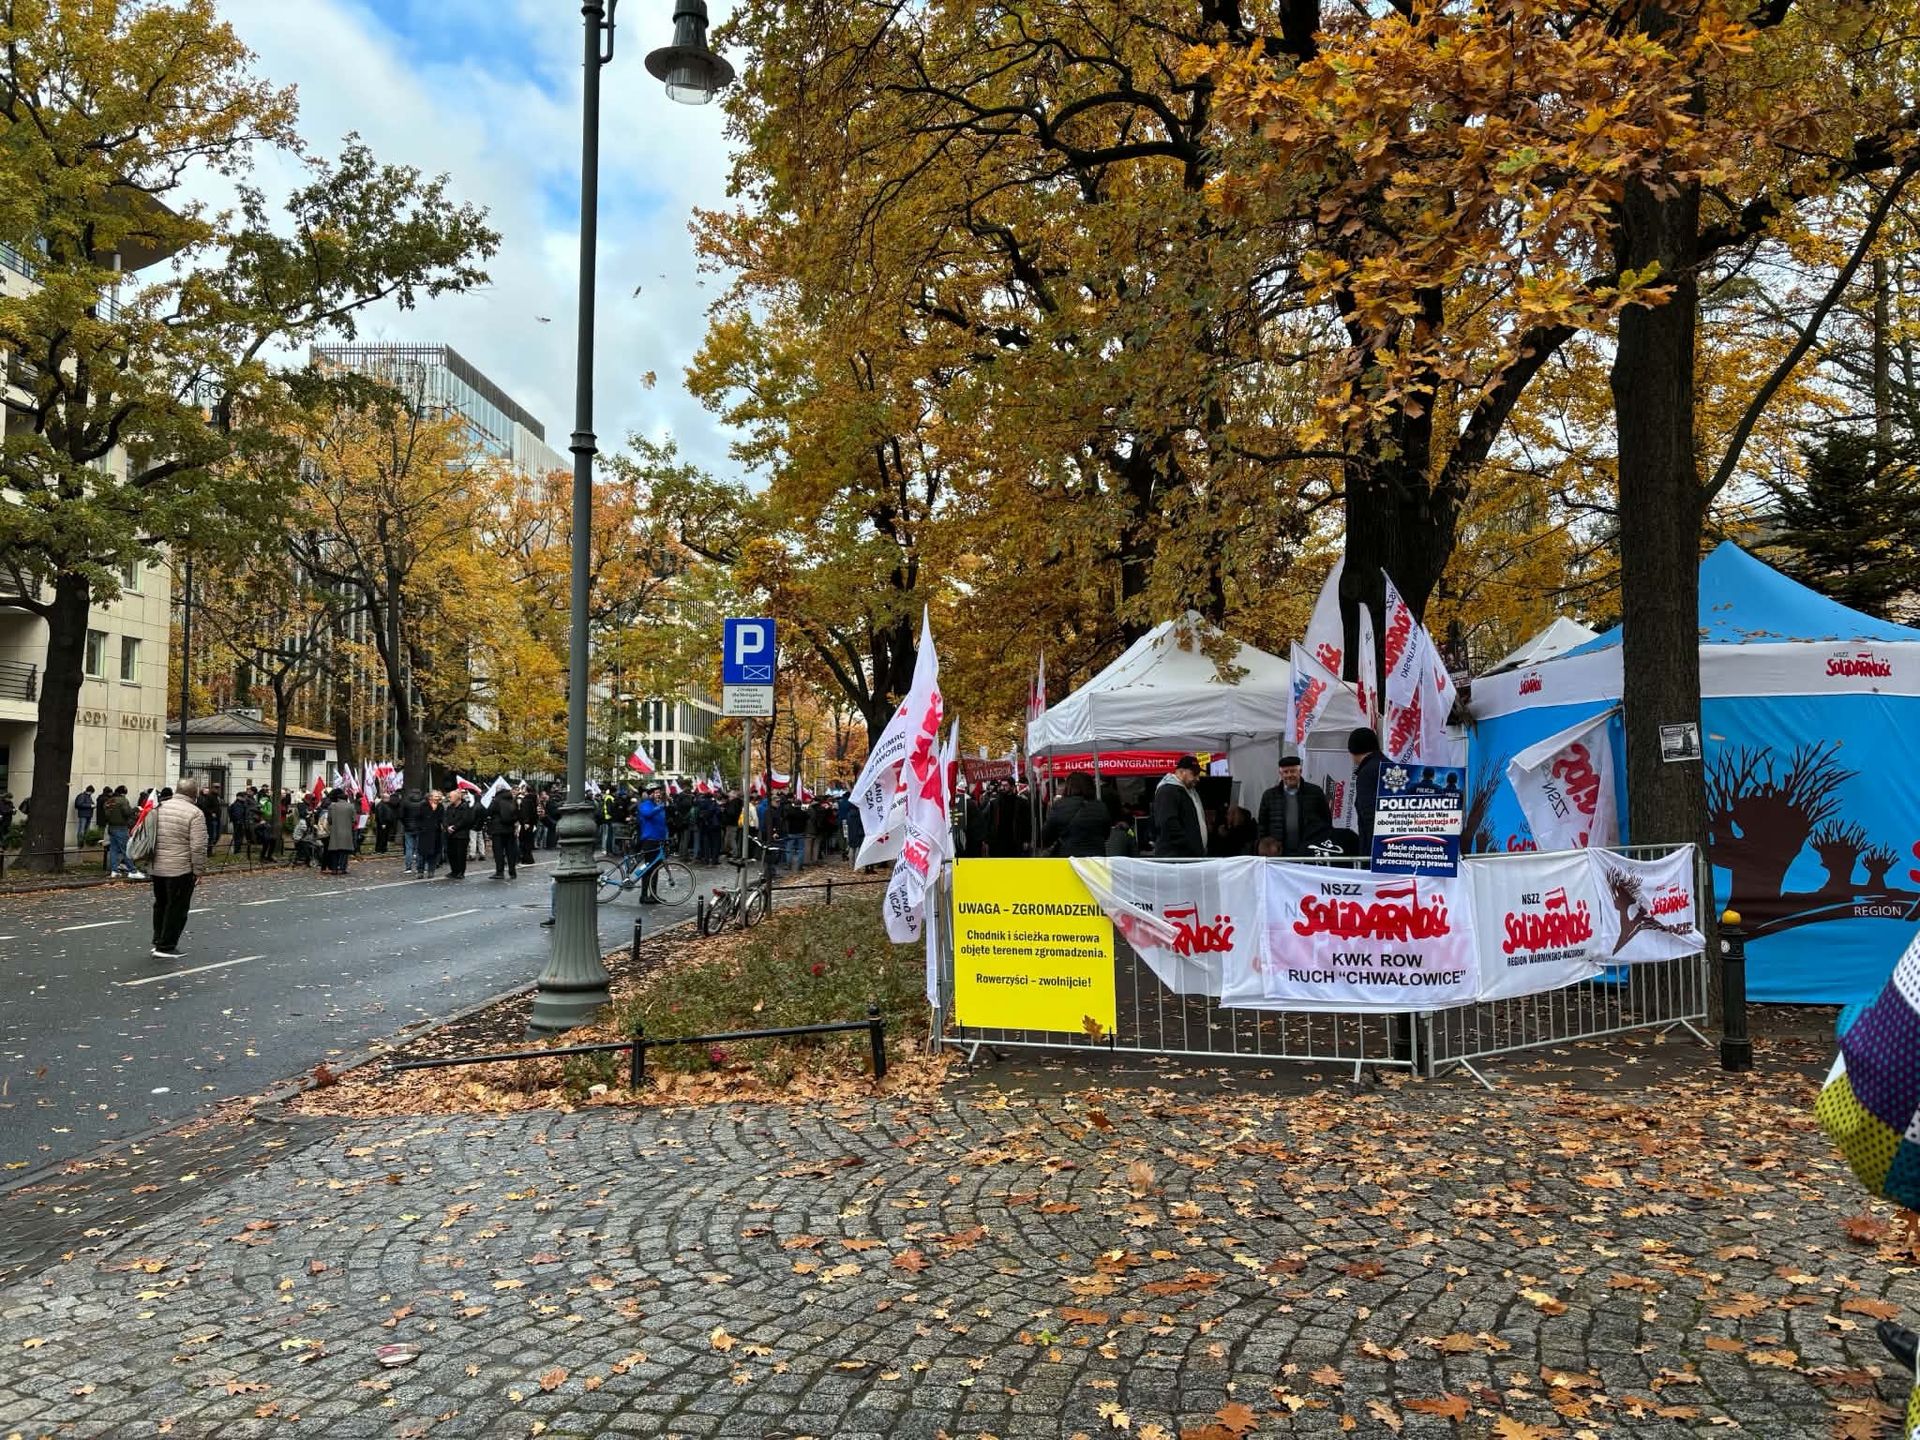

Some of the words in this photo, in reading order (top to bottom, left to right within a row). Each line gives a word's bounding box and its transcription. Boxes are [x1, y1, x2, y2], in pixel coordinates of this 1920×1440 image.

[735, 624, 764, 665] P
[122, 714, 159, 731] HOUSE
[1379, 798, 1458, 810] POLICJANCI!
[1426, 860, 1454, 868] prawem
[1321, 883, 1362, 896] NSZZ
[1521, 893, 1540, 905] NSZZ
[958, 903, 1000, 915] UWAGA
[1854, 905, 1902, 916] REGION
[1293, 893, 1450, 942] SOLIDARNOŚĆ
[1502, 899, 1593, 954] SOLIDARNOŚĆ
[967, 929, 1006, 942] Chodnik
[1007, 930, 1011, 942] i
[1013, 929, 1050, 943] ścieżka
[1052, 934, 1100, 943] rowerowa
[960, 945, 991, 958] objęte
[992, 946, 1033, 957] terenem
[1034, 946, 1107, 959] zgromadzenia.
[1332, 953, 1373, 967] KWK
[1380, 954, 1423, 967] ROW
[1507, 956, 1528, 967] REGION
[976, 973, 1029, 987] Rowerzyści
[1038, 976, 1092, 989] zwolnijcie!
[1288, 969, 1335, 983] RUCH
